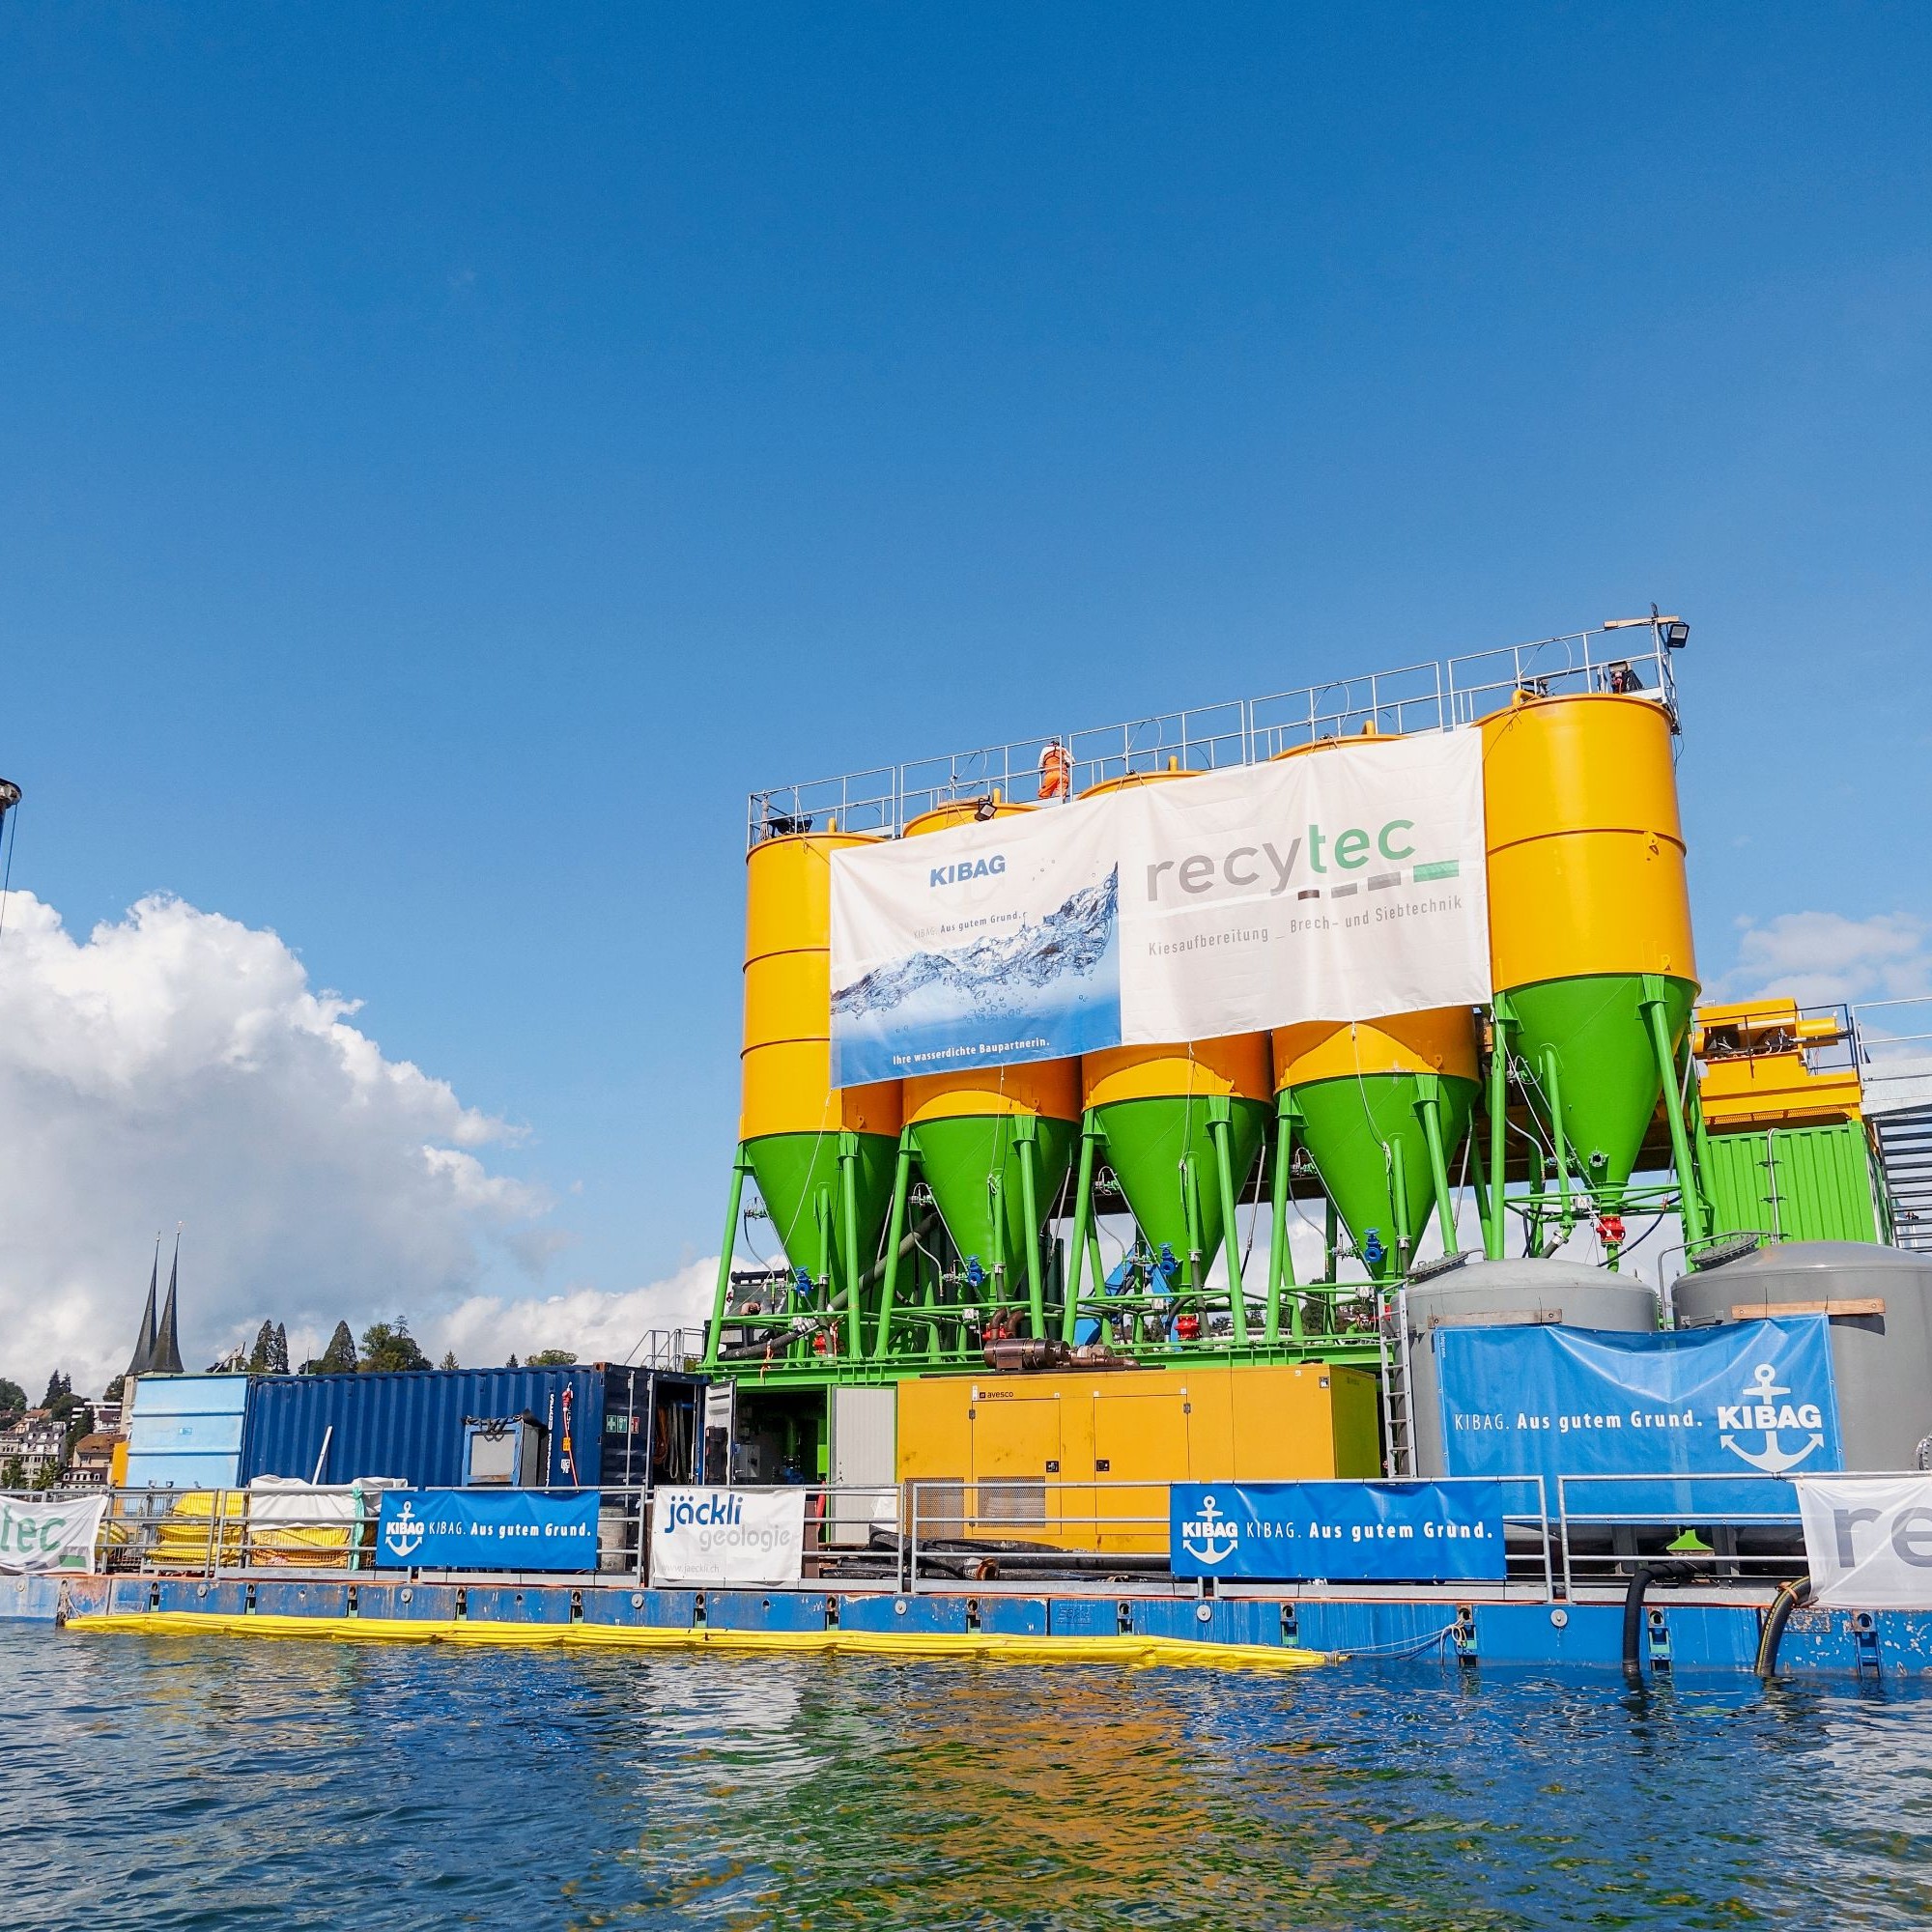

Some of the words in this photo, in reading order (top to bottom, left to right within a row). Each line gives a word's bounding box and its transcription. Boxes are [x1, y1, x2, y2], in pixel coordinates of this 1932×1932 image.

[930, 855, 1006, 887] KIBAG
[1148, 819, 1416, 902] recytec
[941, 924, 955, 934] Aus
[958, 918, 987, 931] gutem
[991, 911, 1021, 923] Grund.
[1149, 926, 1268, 956] Kiesaufbereitung
[1291, 917, 1340, 934] Brech-
[1346, 910, 1370, 928] und
[1376, 895, 1463, 922] Siebtechnik
[893, 1053, 912, 1065] Ihre
[914, 1044, 977, 1063] wasserdichte
[980, 1037, 1050, 1056] Baupartnerin.
[1454, 1413, 1510, 1431] KIBAG.
[1518, 1412, 1550, 1430] Aus
[1559, 1411, 1622, 1435] gutem
[1631, 1409, 1703, 1428] Grund.
[1718, 1405, 1822, 1430] KIBAG
[665, 1493, 744, 1533] jäckli
[385, 1521, 425, 1535] KIBAG
[429, 1521, 467, 1536] KIBAG.
[470, 1522, 494, 1537] Aus
[498, 1522, 540, 1539] gutem
[545, 1522, 591, 1537] Grund.
[699, 1524, 791, 1553] geologie
[1182, 1521, 1238, 1538] KIBAG
[1246, 1521, 1301, 1539] KIBAG.
[1309, 1521, 1342, 1539] Aus
[1351, 1521, 1413, 1543] gutem
[1424, 1521, 1492, 1539] Grund.
[1833, 1507, 1932, 1569] re
